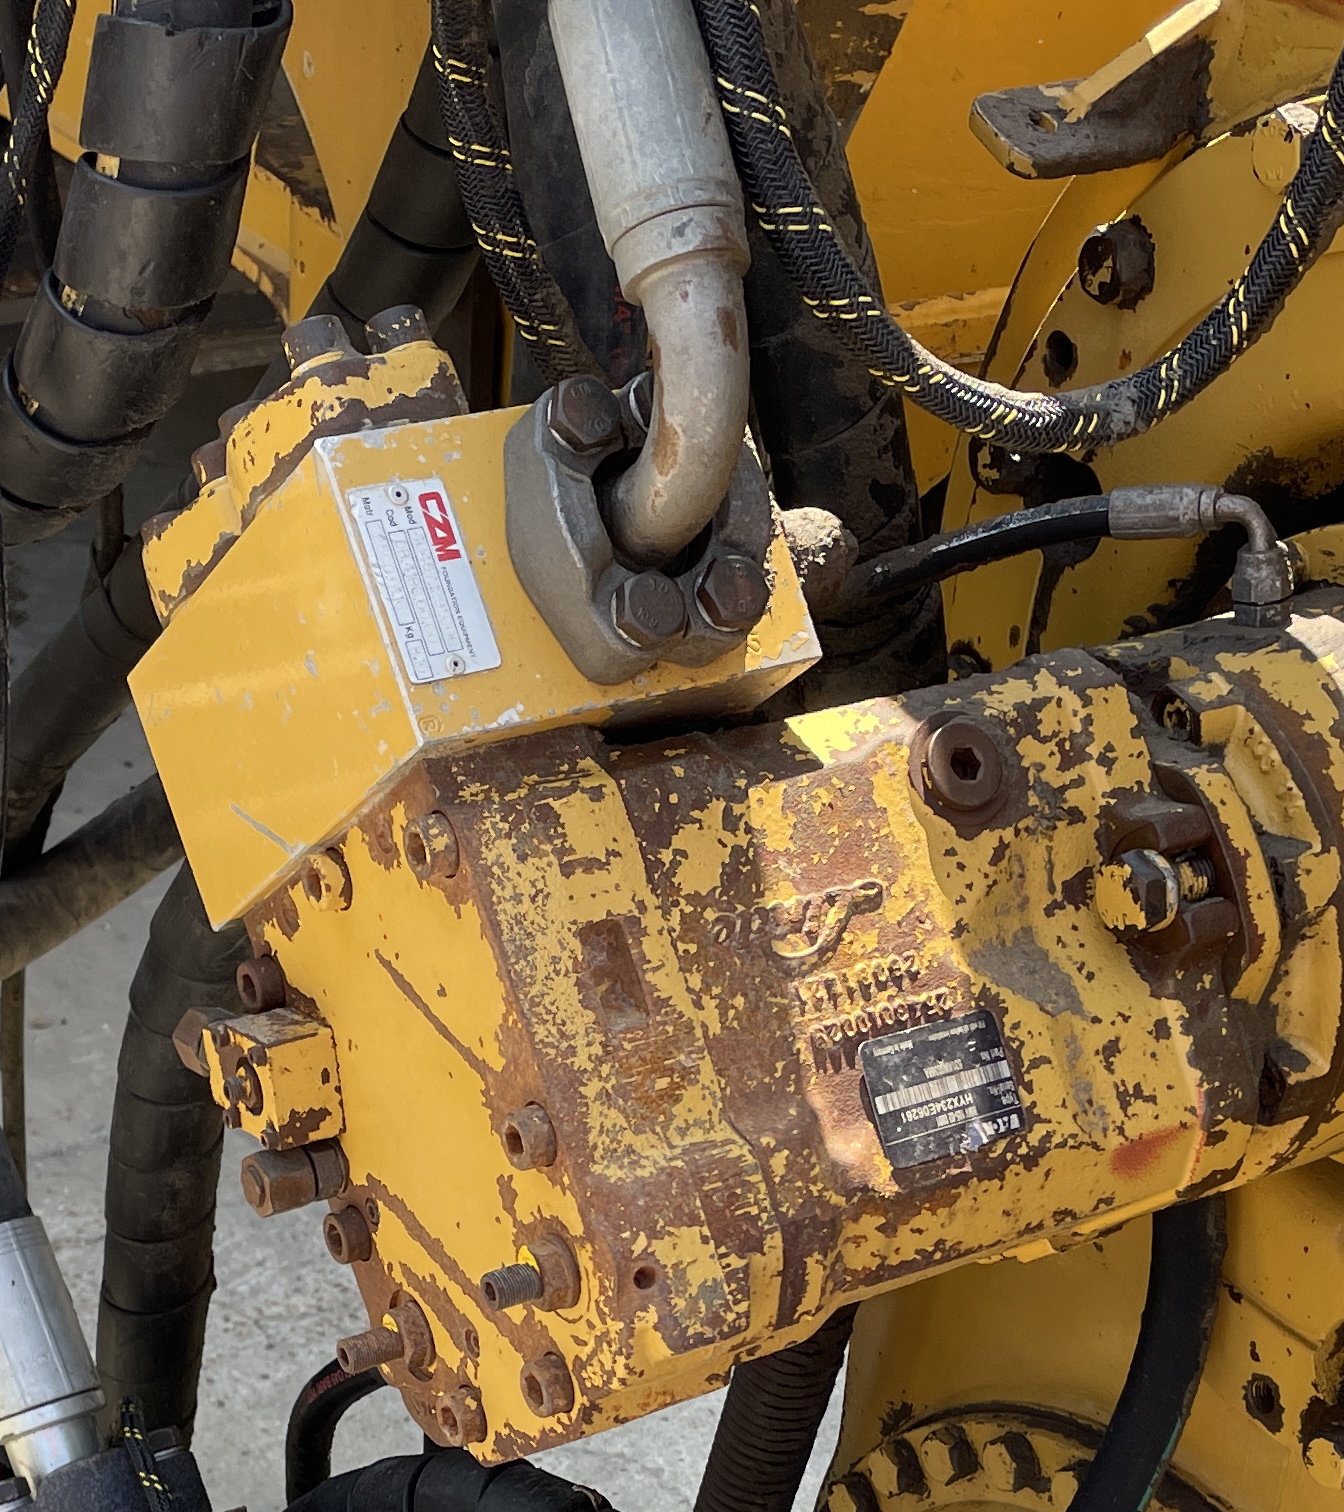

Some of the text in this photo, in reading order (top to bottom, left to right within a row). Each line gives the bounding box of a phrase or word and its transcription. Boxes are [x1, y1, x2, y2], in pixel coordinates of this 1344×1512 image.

[418, 490, 462, 563] CZM
[441, 566, 475, 658] FOUNDATION EQUIPMENT
